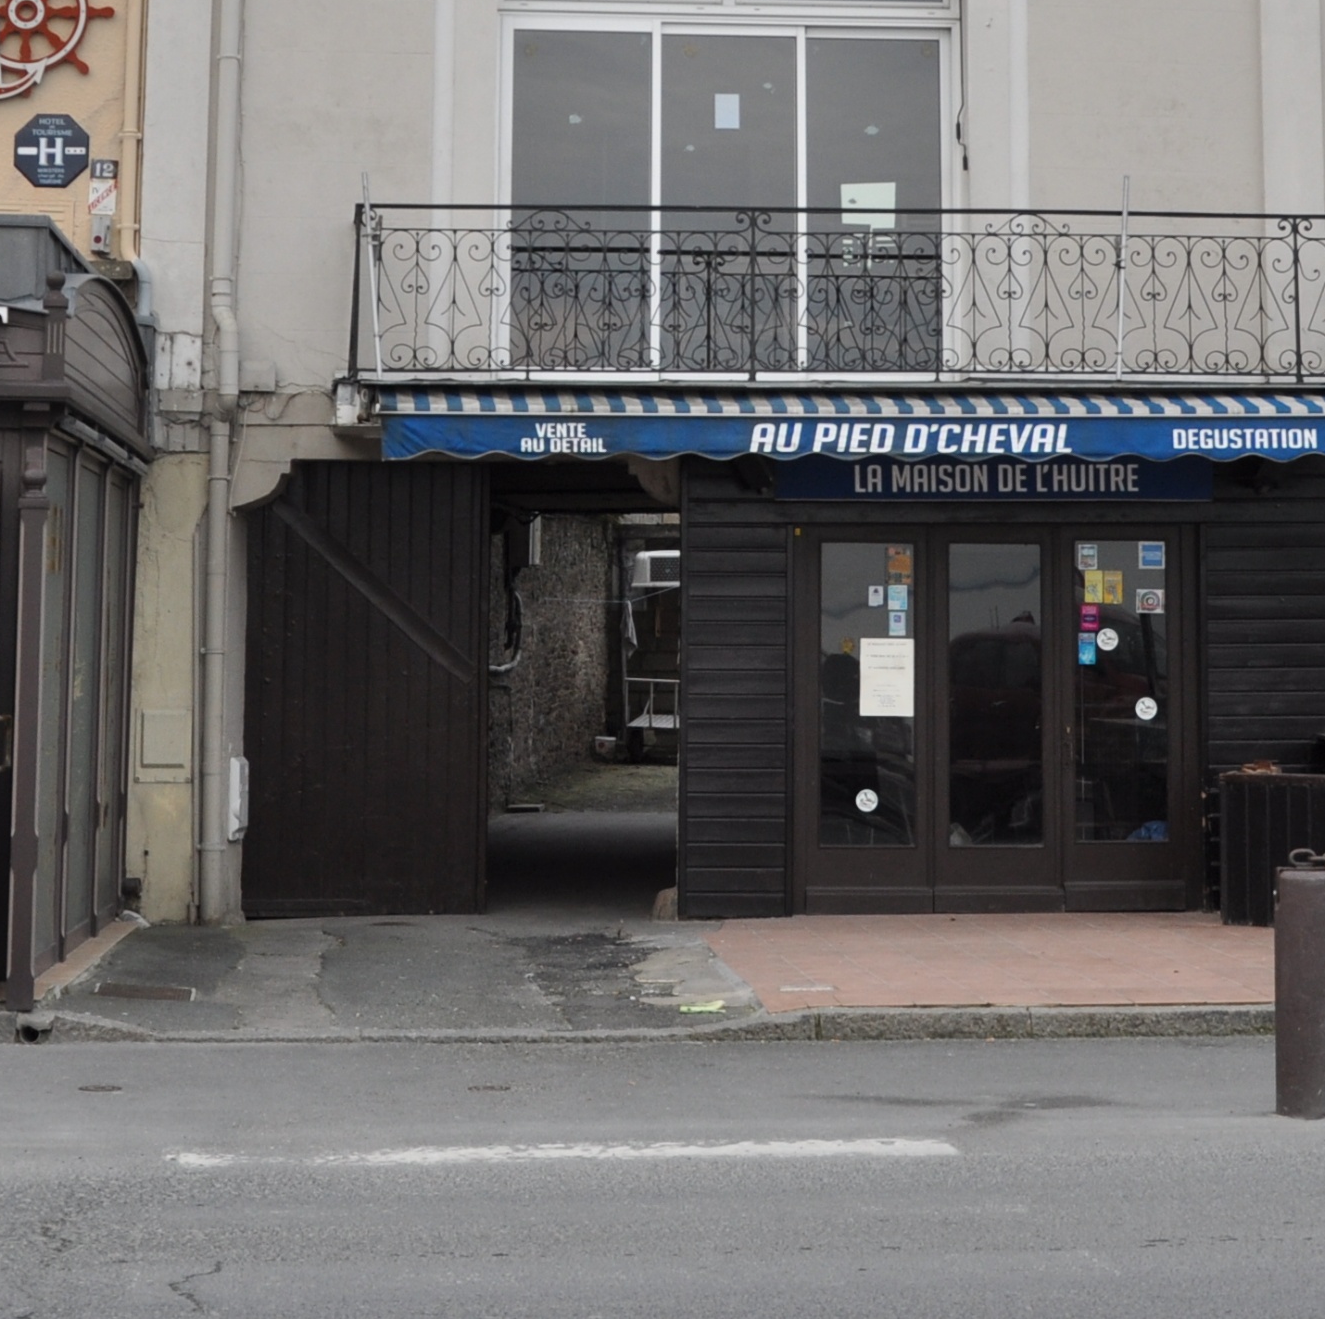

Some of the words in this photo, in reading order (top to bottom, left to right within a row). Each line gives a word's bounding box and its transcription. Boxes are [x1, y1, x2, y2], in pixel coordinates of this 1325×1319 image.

[38, 117, 66, 125] HOTEL
[38, 137, 65, 166] H
[95, 162, 114, 177] 12
[535, 422, 587, 438] VENTE
[750, 422, 799, 454] AU
[812, 423, 895, 454] PIED
[904, 423, 1072, 454] D'CHEVAL
[1172, 428, 1318, 450] DEGUSTATION
[520, 437, 545, 453] AU
[549, 437, 607, 454] DETAIL
[854, 464, 882, 494] LA
[892, 464, 990, 494] MAISON
[997, 463, 1028, 493] DE
[1036, 463, 1139, 493] L'HUITRE
